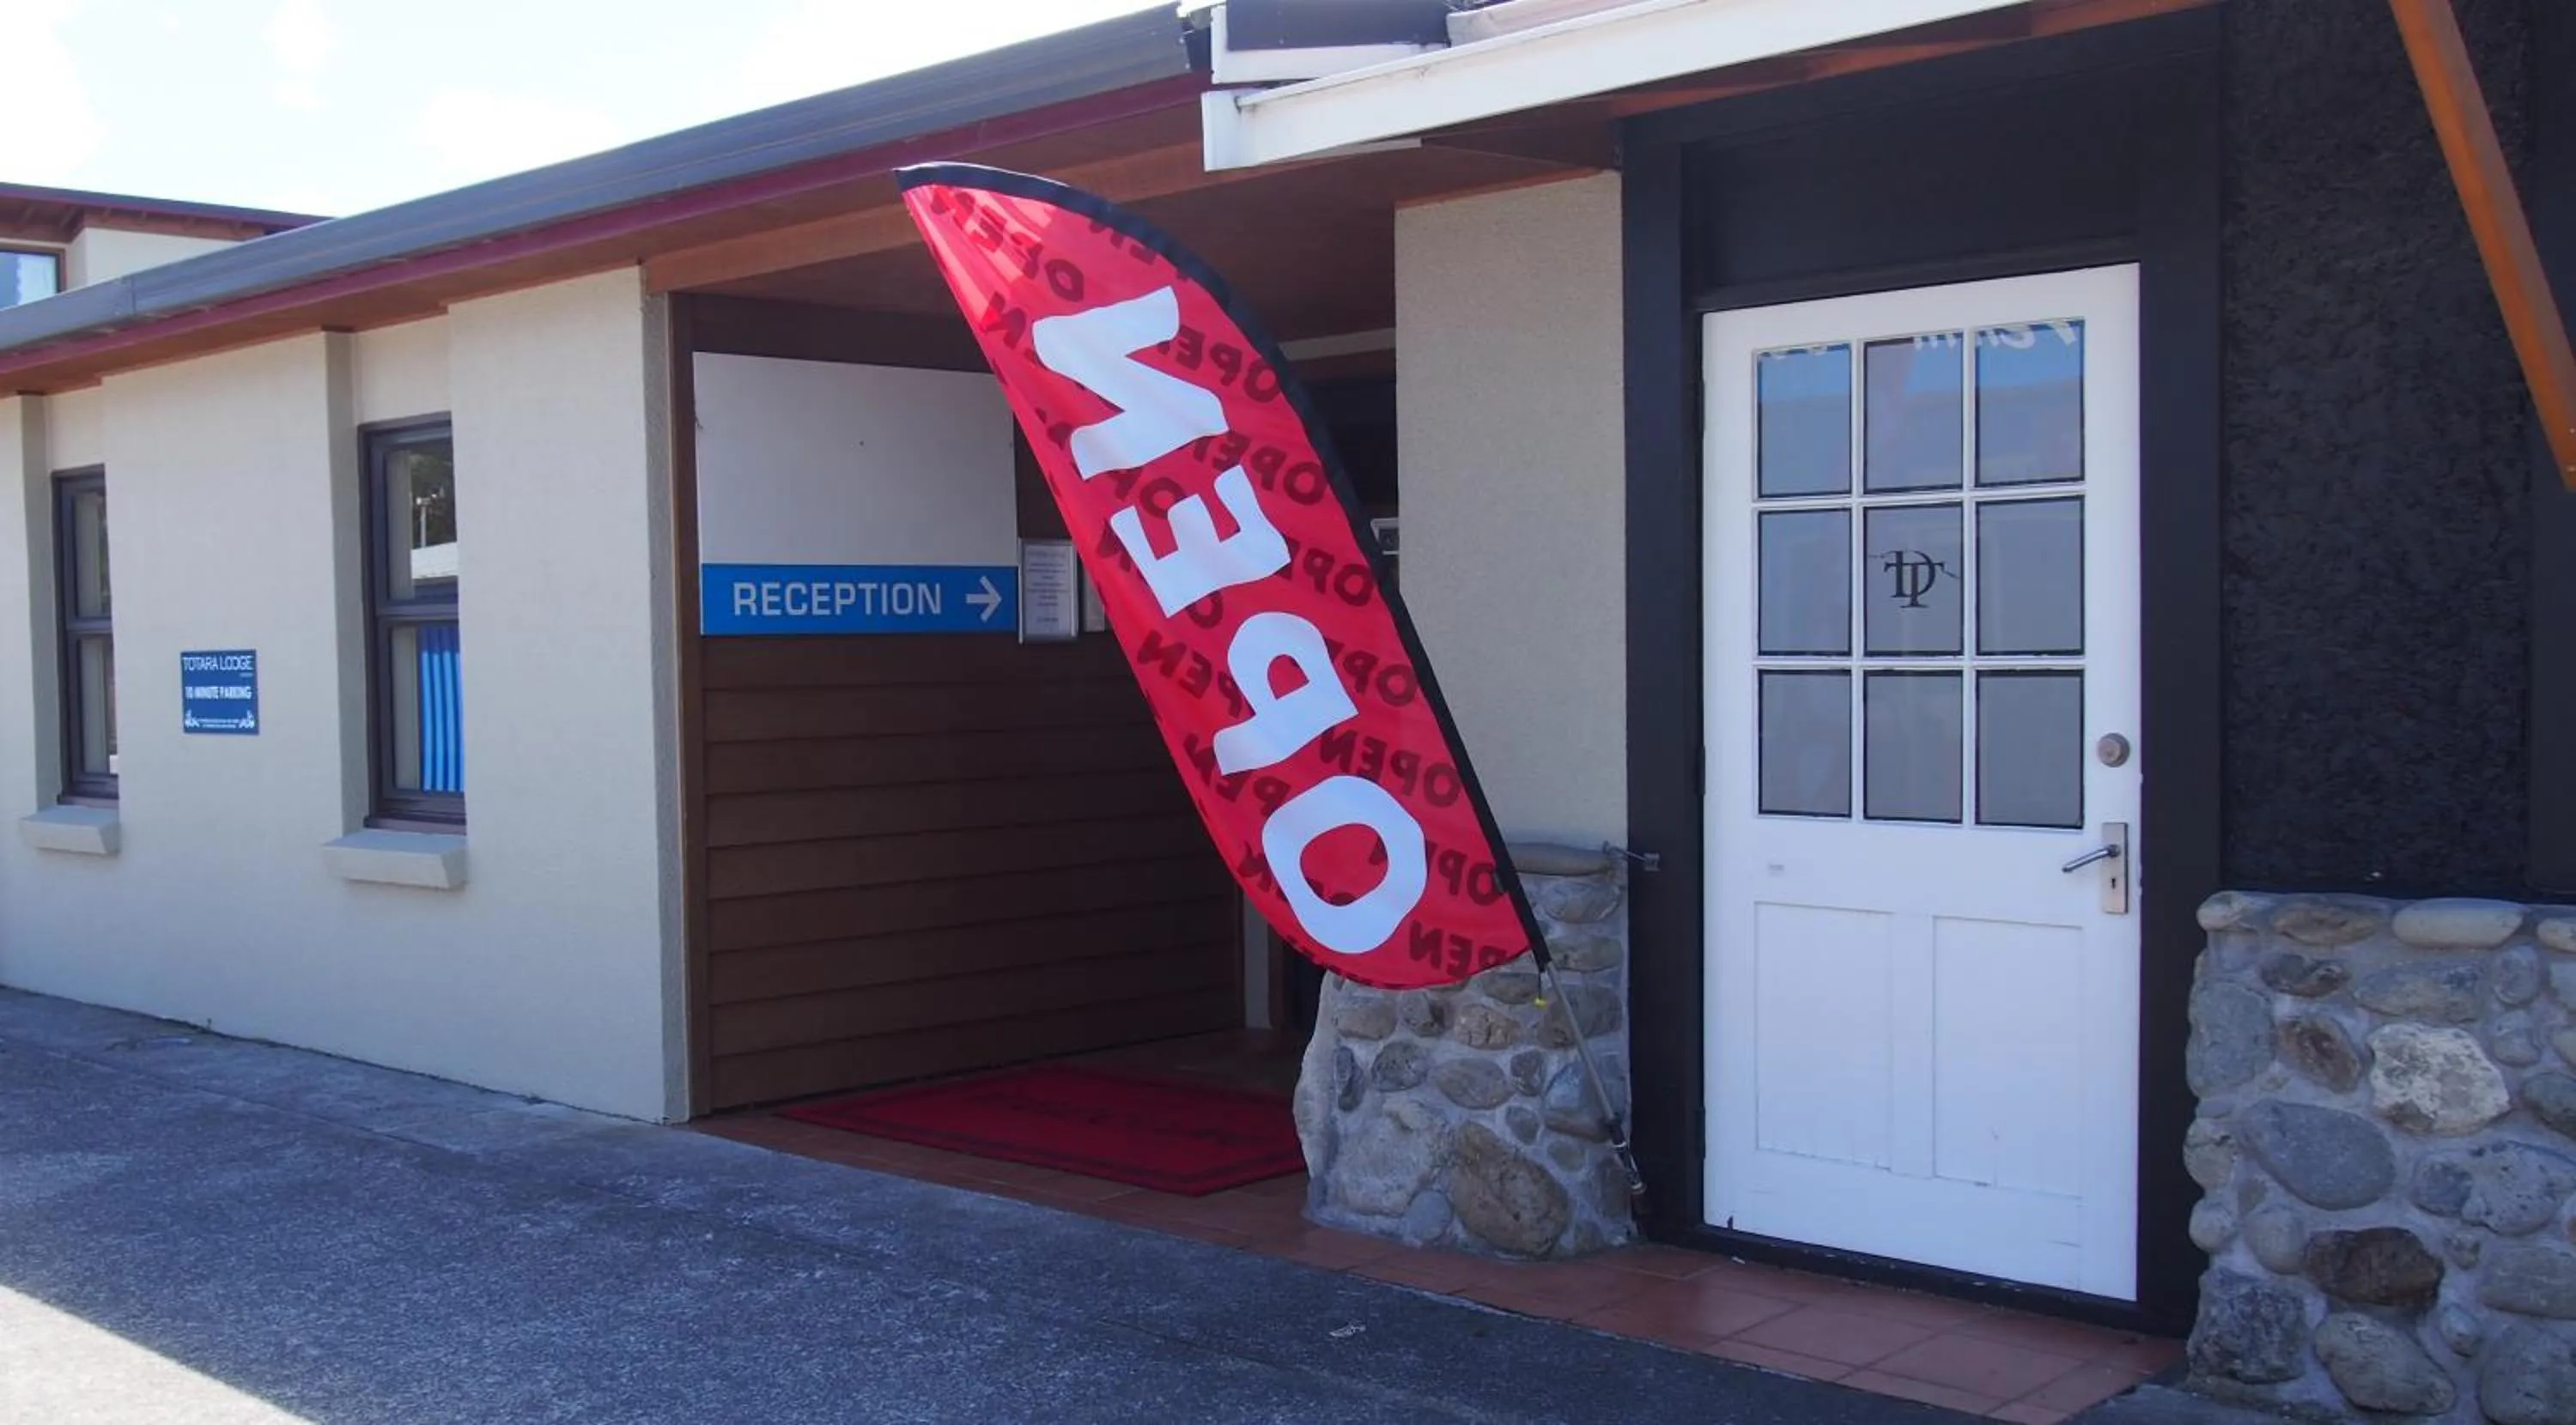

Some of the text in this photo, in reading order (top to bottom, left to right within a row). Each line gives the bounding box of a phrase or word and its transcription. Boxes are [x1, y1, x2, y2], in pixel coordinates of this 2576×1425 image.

[733, 581, 942, 615] RECEPTION
[183, 655, 254, 670] TOTARA LODGE
